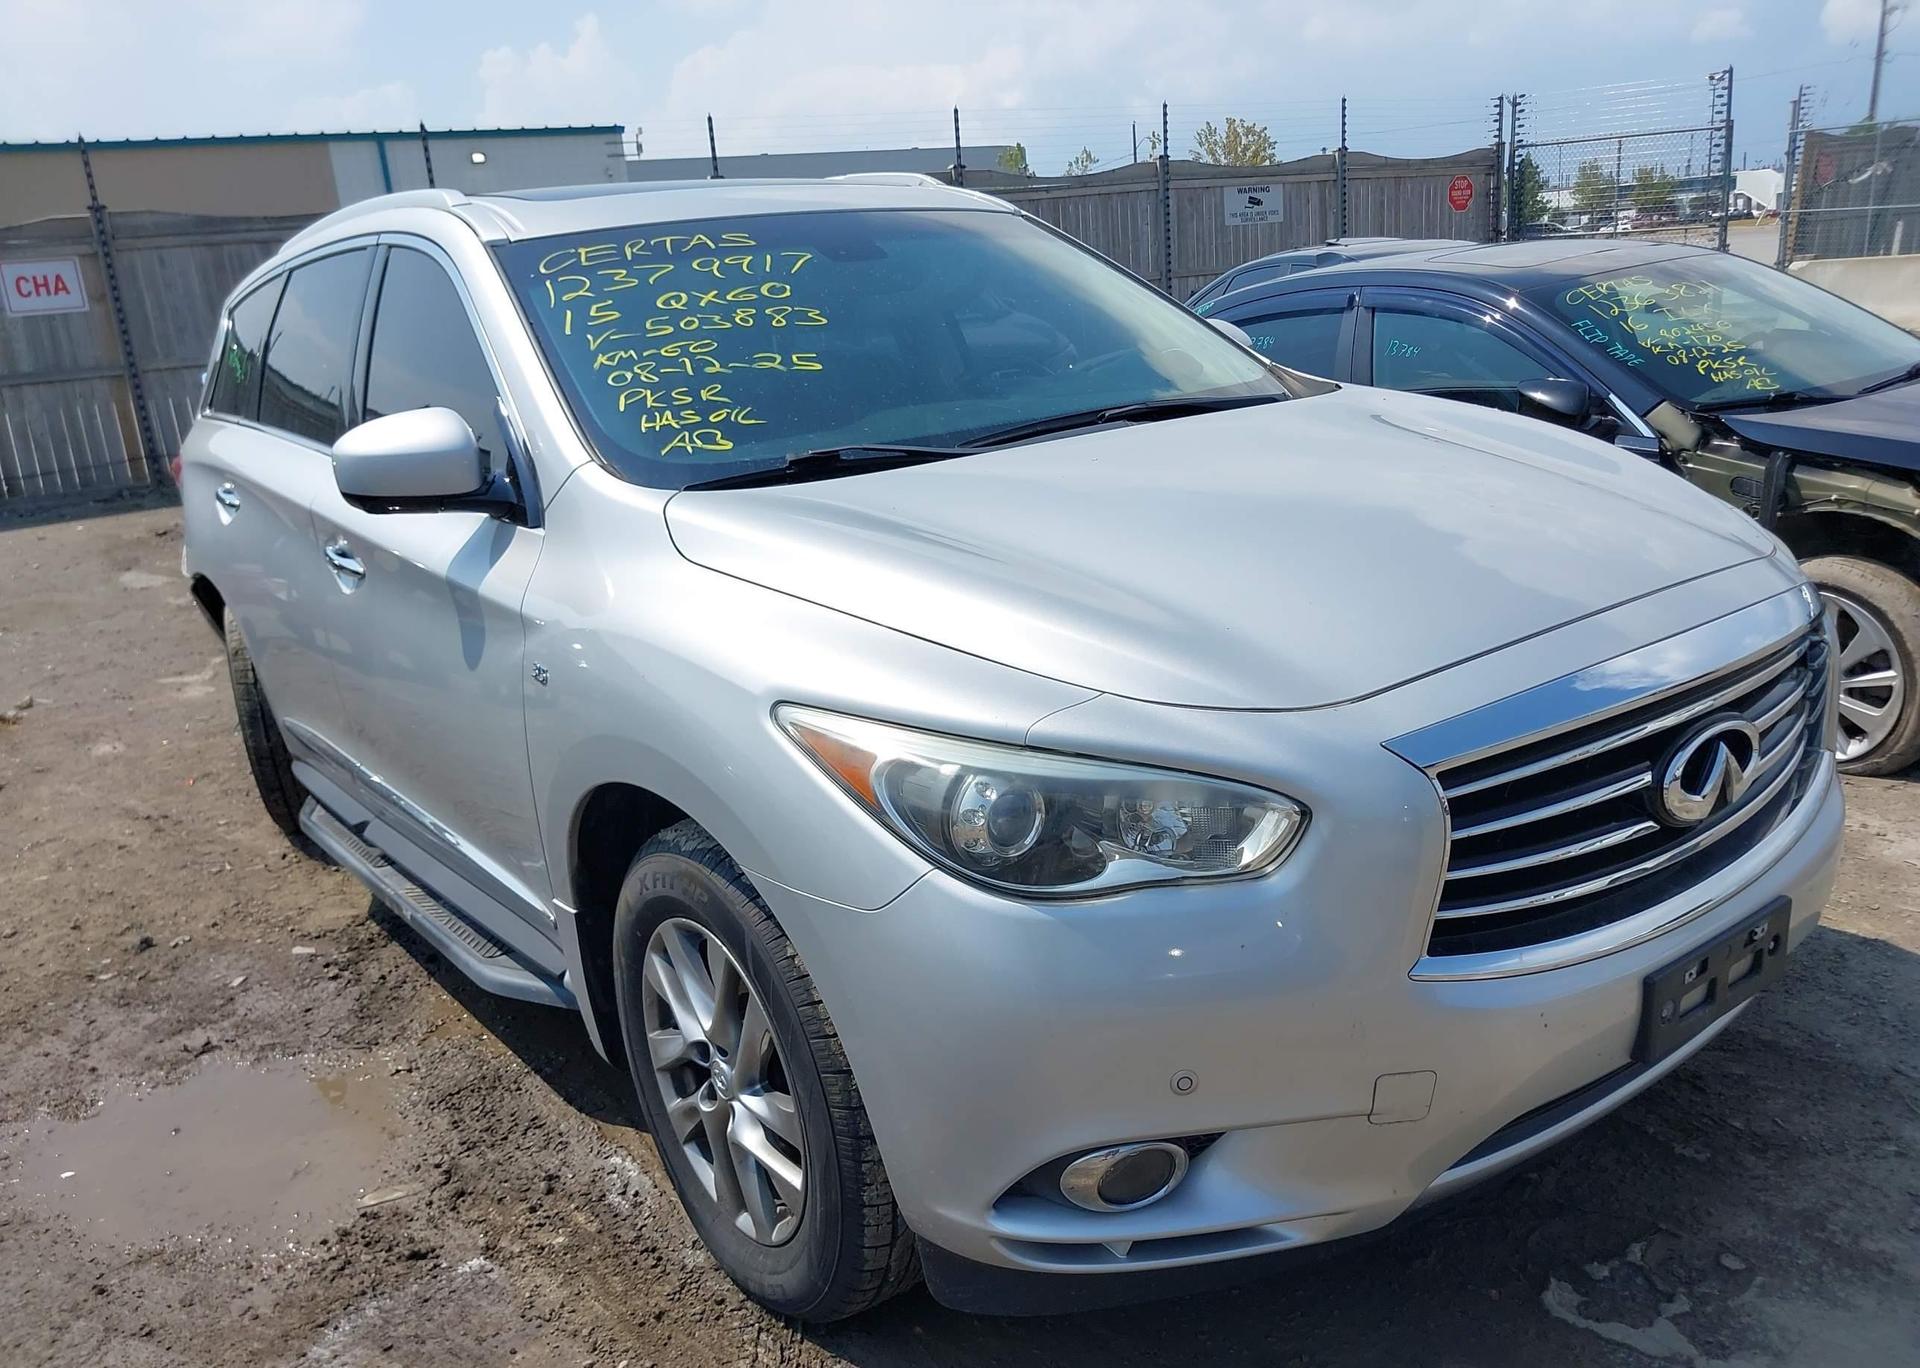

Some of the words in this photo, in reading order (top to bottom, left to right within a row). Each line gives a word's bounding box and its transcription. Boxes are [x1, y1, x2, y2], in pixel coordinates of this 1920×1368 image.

[1236, 186, 1271, 195] WARNING
[1454, 179, 1469, 190] STOP
[539, 233, 757, 275] CERTAS
[15, 273, 71, 299] CHA
[656, 281, 792, 311] QX60
[1384, 338, 1422, 358] 13784
[1571, 319, 1609, 344] FLIP
[1606, 341, 1646, 367] TAPE
[618, 384, 732, 412] PKSR
